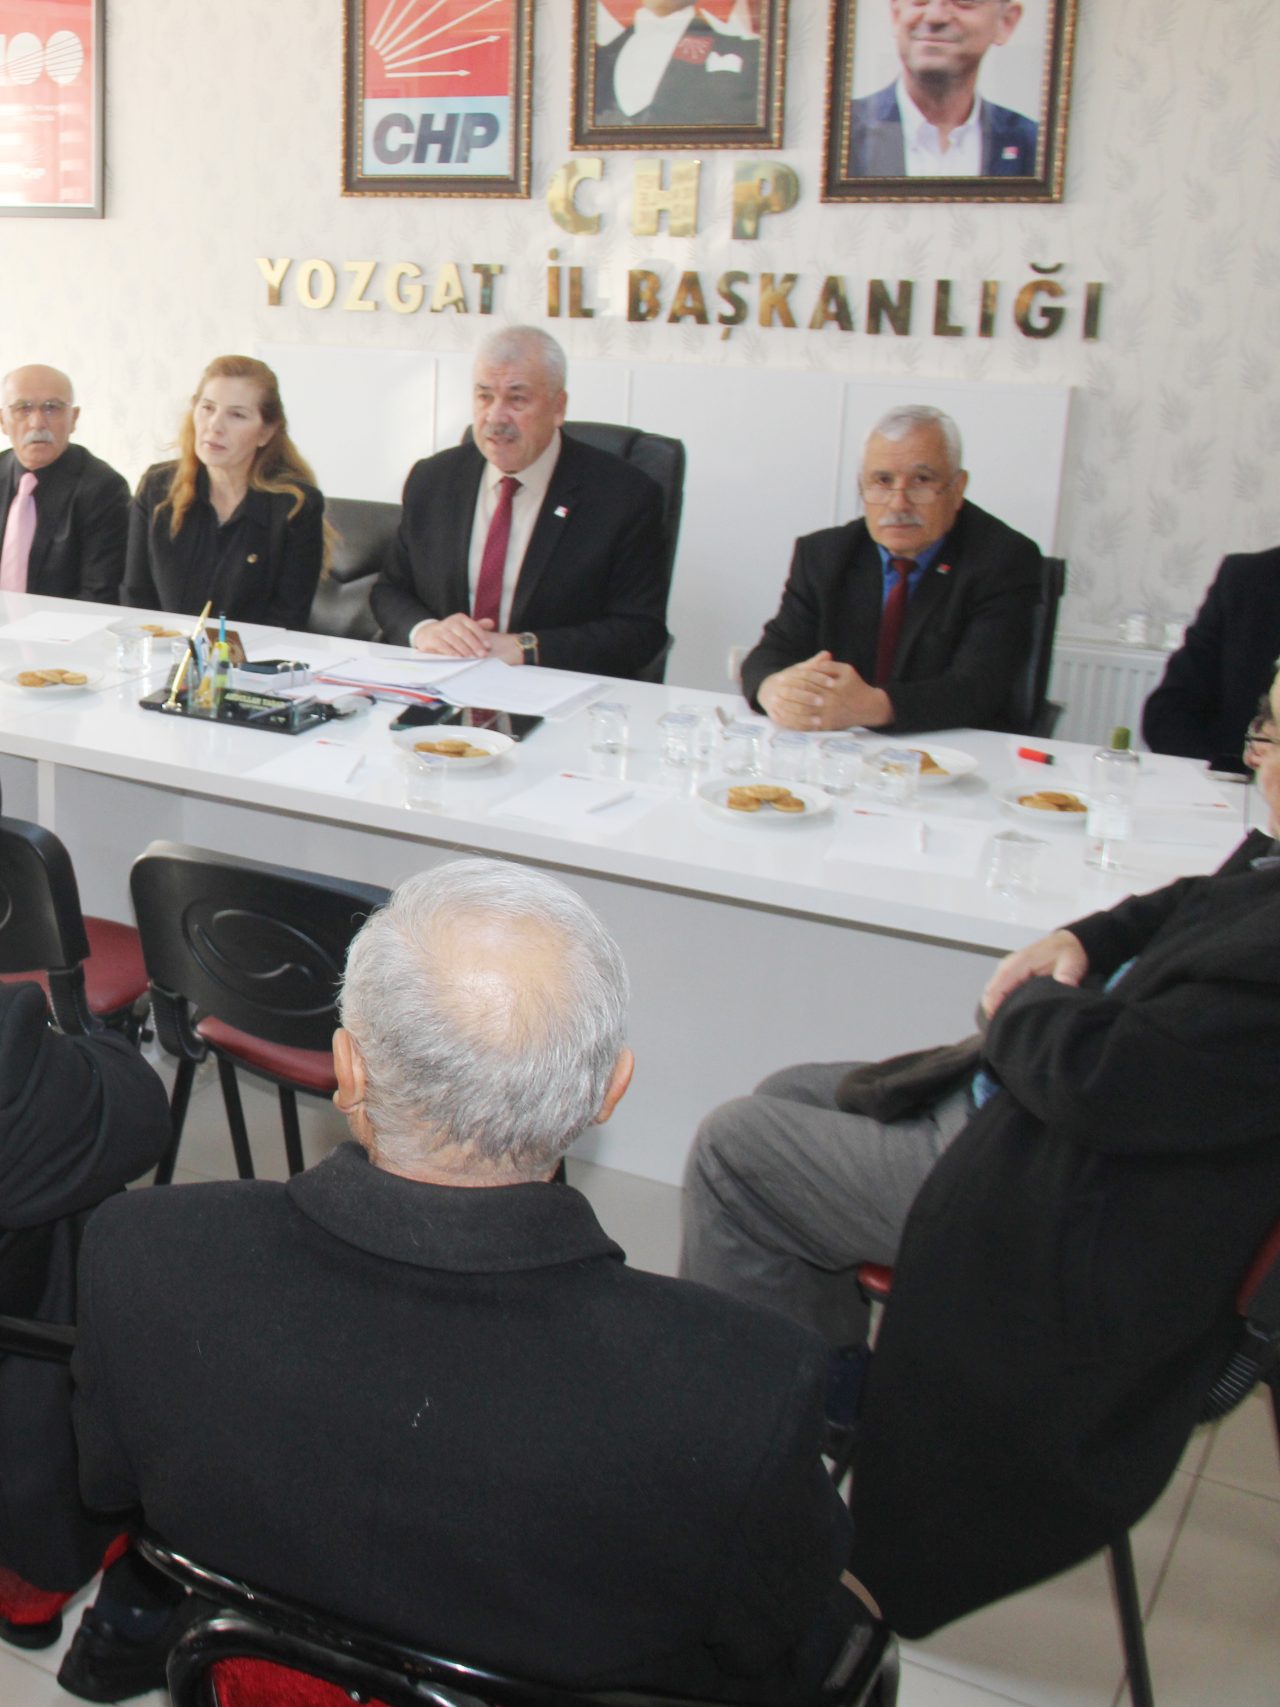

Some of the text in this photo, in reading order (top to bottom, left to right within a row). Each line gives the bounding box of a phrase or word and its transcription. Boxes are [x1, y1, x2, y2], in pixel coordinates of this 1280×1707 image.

[372, 112, 500, 165] CHP
[547, 157, 800, 239] CHP
[256, 247, 1106, 343] YOZGAT İL BAŞKANLIĞI
